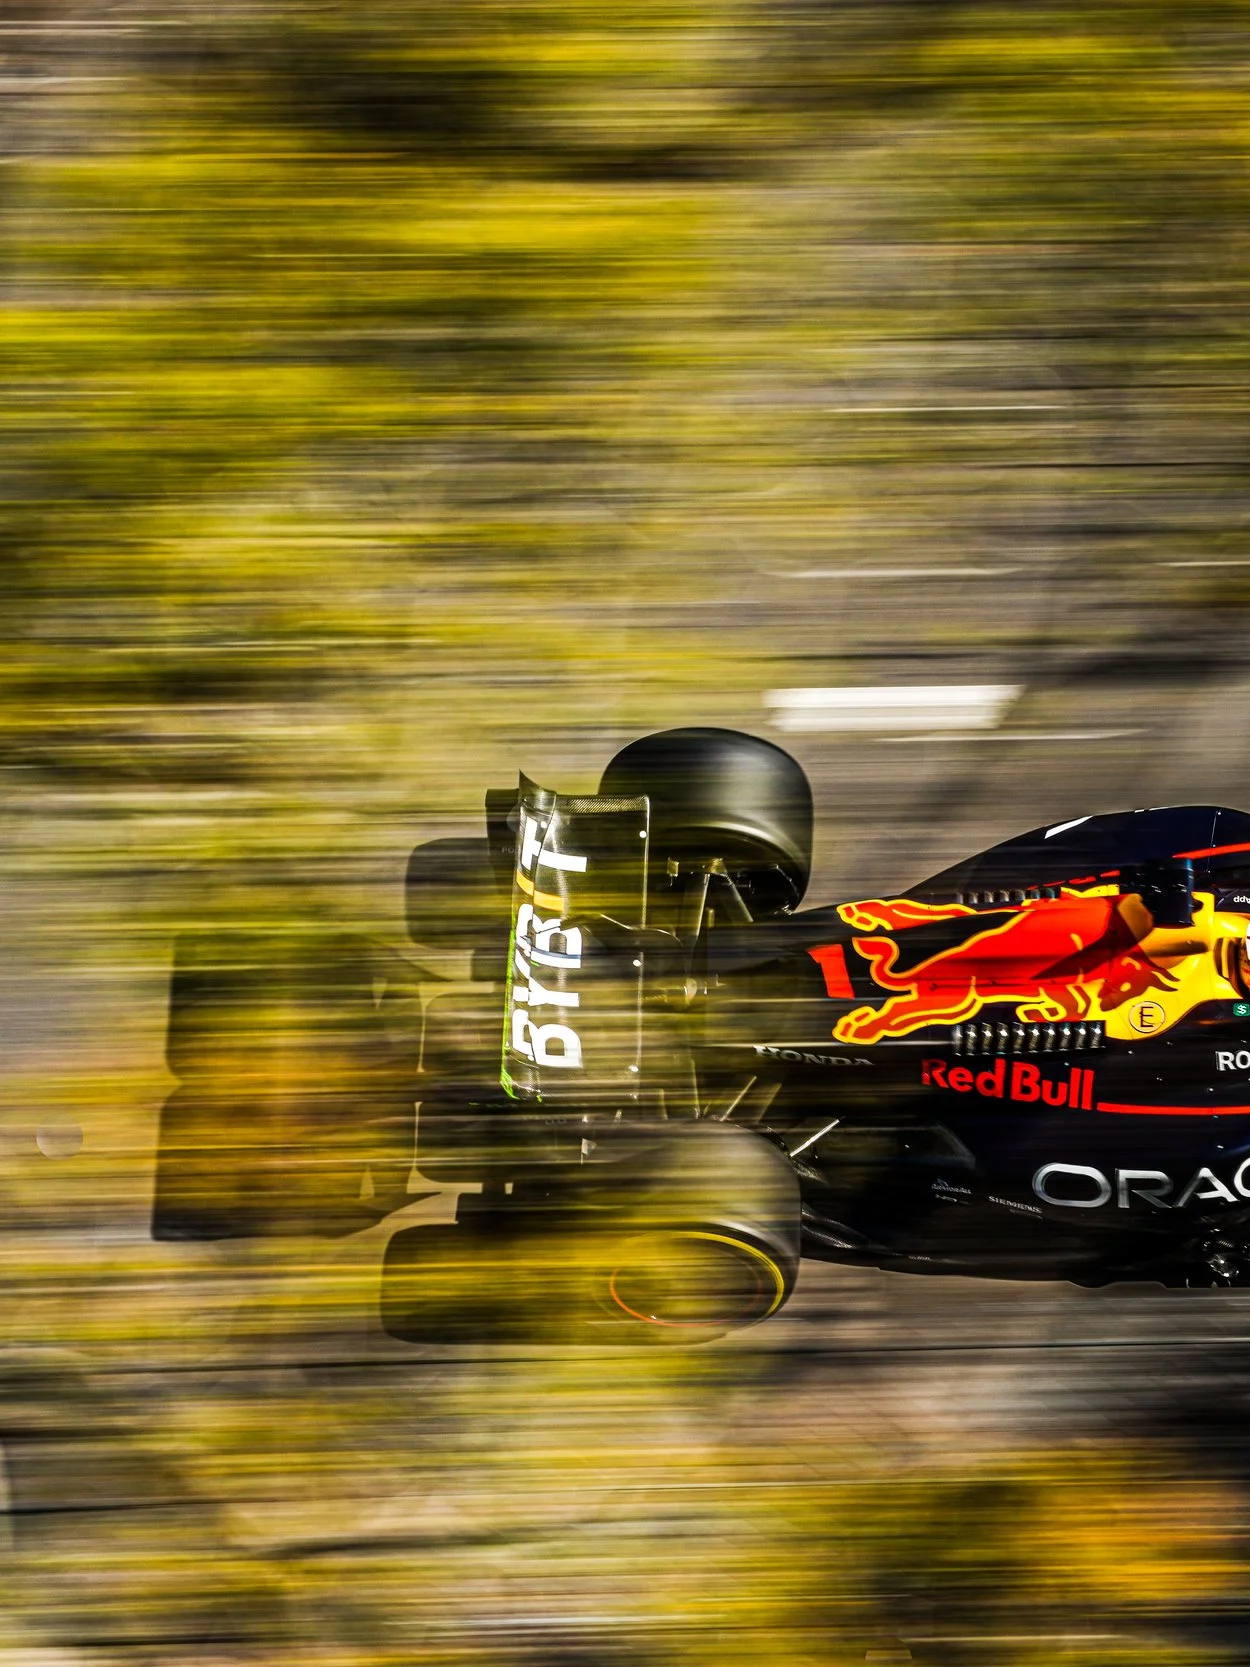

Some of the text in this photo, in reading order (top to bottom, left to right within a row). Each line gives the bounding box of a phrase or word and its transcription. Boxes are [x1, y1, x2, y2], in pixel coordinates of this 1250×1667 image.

[512, 816, 588, 1070] BYBIT
[807, 943, 855, 999] 1
[752, 1045, 875, 1066] HONDA
[921, 1058, 1095, 1110] Red Bull
